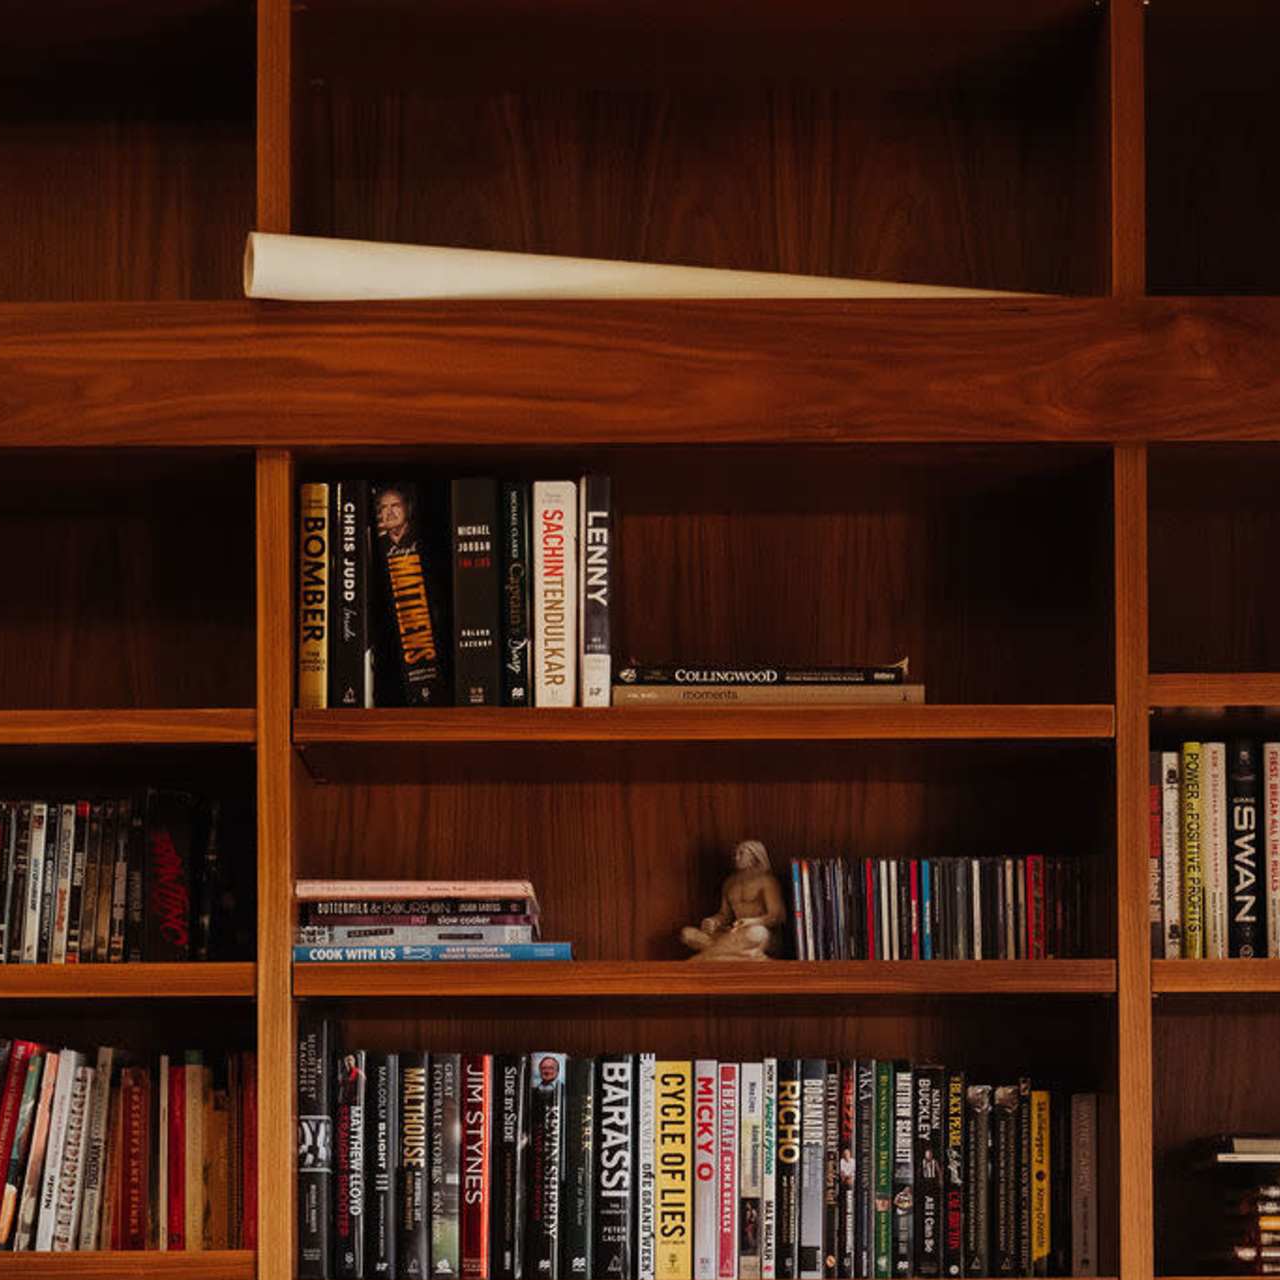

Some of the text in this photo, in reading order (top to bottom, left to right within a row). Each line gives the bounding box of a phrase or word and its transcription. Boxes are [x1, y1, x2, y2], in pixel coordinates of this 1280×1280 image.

[344, 502, 359, 601] CHRIS JUDD
[587, 510, 610, 607] LENNY
[303, 517, 326, 642] BOMBER
[387, 554, 437, 667] MATTHEWS
[674, 668, 779, 683] COLLINGWOOD
[1269, 752, 1279, 782] FIRST,
[1269, 784, 1279, 816] BREAK
[1186, 753, 1202, 934] POWER POSITIVE PROFITS
[1270, 818, 1279, 836] ALL
[1232, 805, 1257, 923] SWAN
[1270, 860, 1280, 892] RULES
[308, 948, 397, 961] COOK WITH US
[13, 1045, 26, 1061] Why
[307, 1034, 318, 1101] MIGHTIEST
[444, 1062, 454, 1098] GREAT
[503, 1065, 518, 1095] SIDE
[766, 1064, 775, 1083] HOW
[766, 1084, 775, 1095] TO
[826, 1073, 839, 1102] BETTY
[859, 1066, 873, 1102] AKA
[432, 1063, 444, 1128] FOOTBALL
[504, 1096, 516, 1113] BY
[720, 1080, 736, 1109] THE
[802, 1079, 824, 1147] BOGANAIRE
[918, 1078, 932, 1142] BUCKLEY
[931, 1088, 941, 1130] NATHAN
[948, 1082, 962, 1115] BLACK
[338, 1105, 350, 1170] STRAIGHT
[377, 1065, 388, 1170] MALCOLM BLIGHT
[403, 1067, 426, 1169] MALTHOUSE
[465, 1063, 486, 1205] JIM STYNES
[503, 1113, 517, 1143] SIDE
[601, 1061, 631, 1198] BARASSI
[696, 1076, 714, 1182] MICKY O
[720, 1109, 736, 1154] DRAFT
[779, 1080, 801, 1165] RICHO
[895, 1071, 913, 1164] MATTHEW SCARLETT
[948, 1116, 962, 1148] PEARL
[349, 1105, 363, 1217] MATTHEW LLOYD
[432, 1132, 445, 1186] STORIES
[660, 1072, 686, 1239] CYCLE OF LIES
[763, 1138, 777, 1176] Python
[1078, 1102, 1093, 1192] WAYNE CAREY
[43, 1173, 57, 1209] Miele
[543, 1104, 560, 1239] KEVIN SHEEDY
[722, 1155, 733, 1190] EMMA
[641, 1162, 654, 1273] ONE GRAND WEEK
[764, 1200, 775, 1222] MAX
[923, 1195, 935, 1209] All
[764, 1223, 775, 1261] WALKER
[923, 1218, 935, 1238] Can
[923, 1239, 935, 1254] Be
